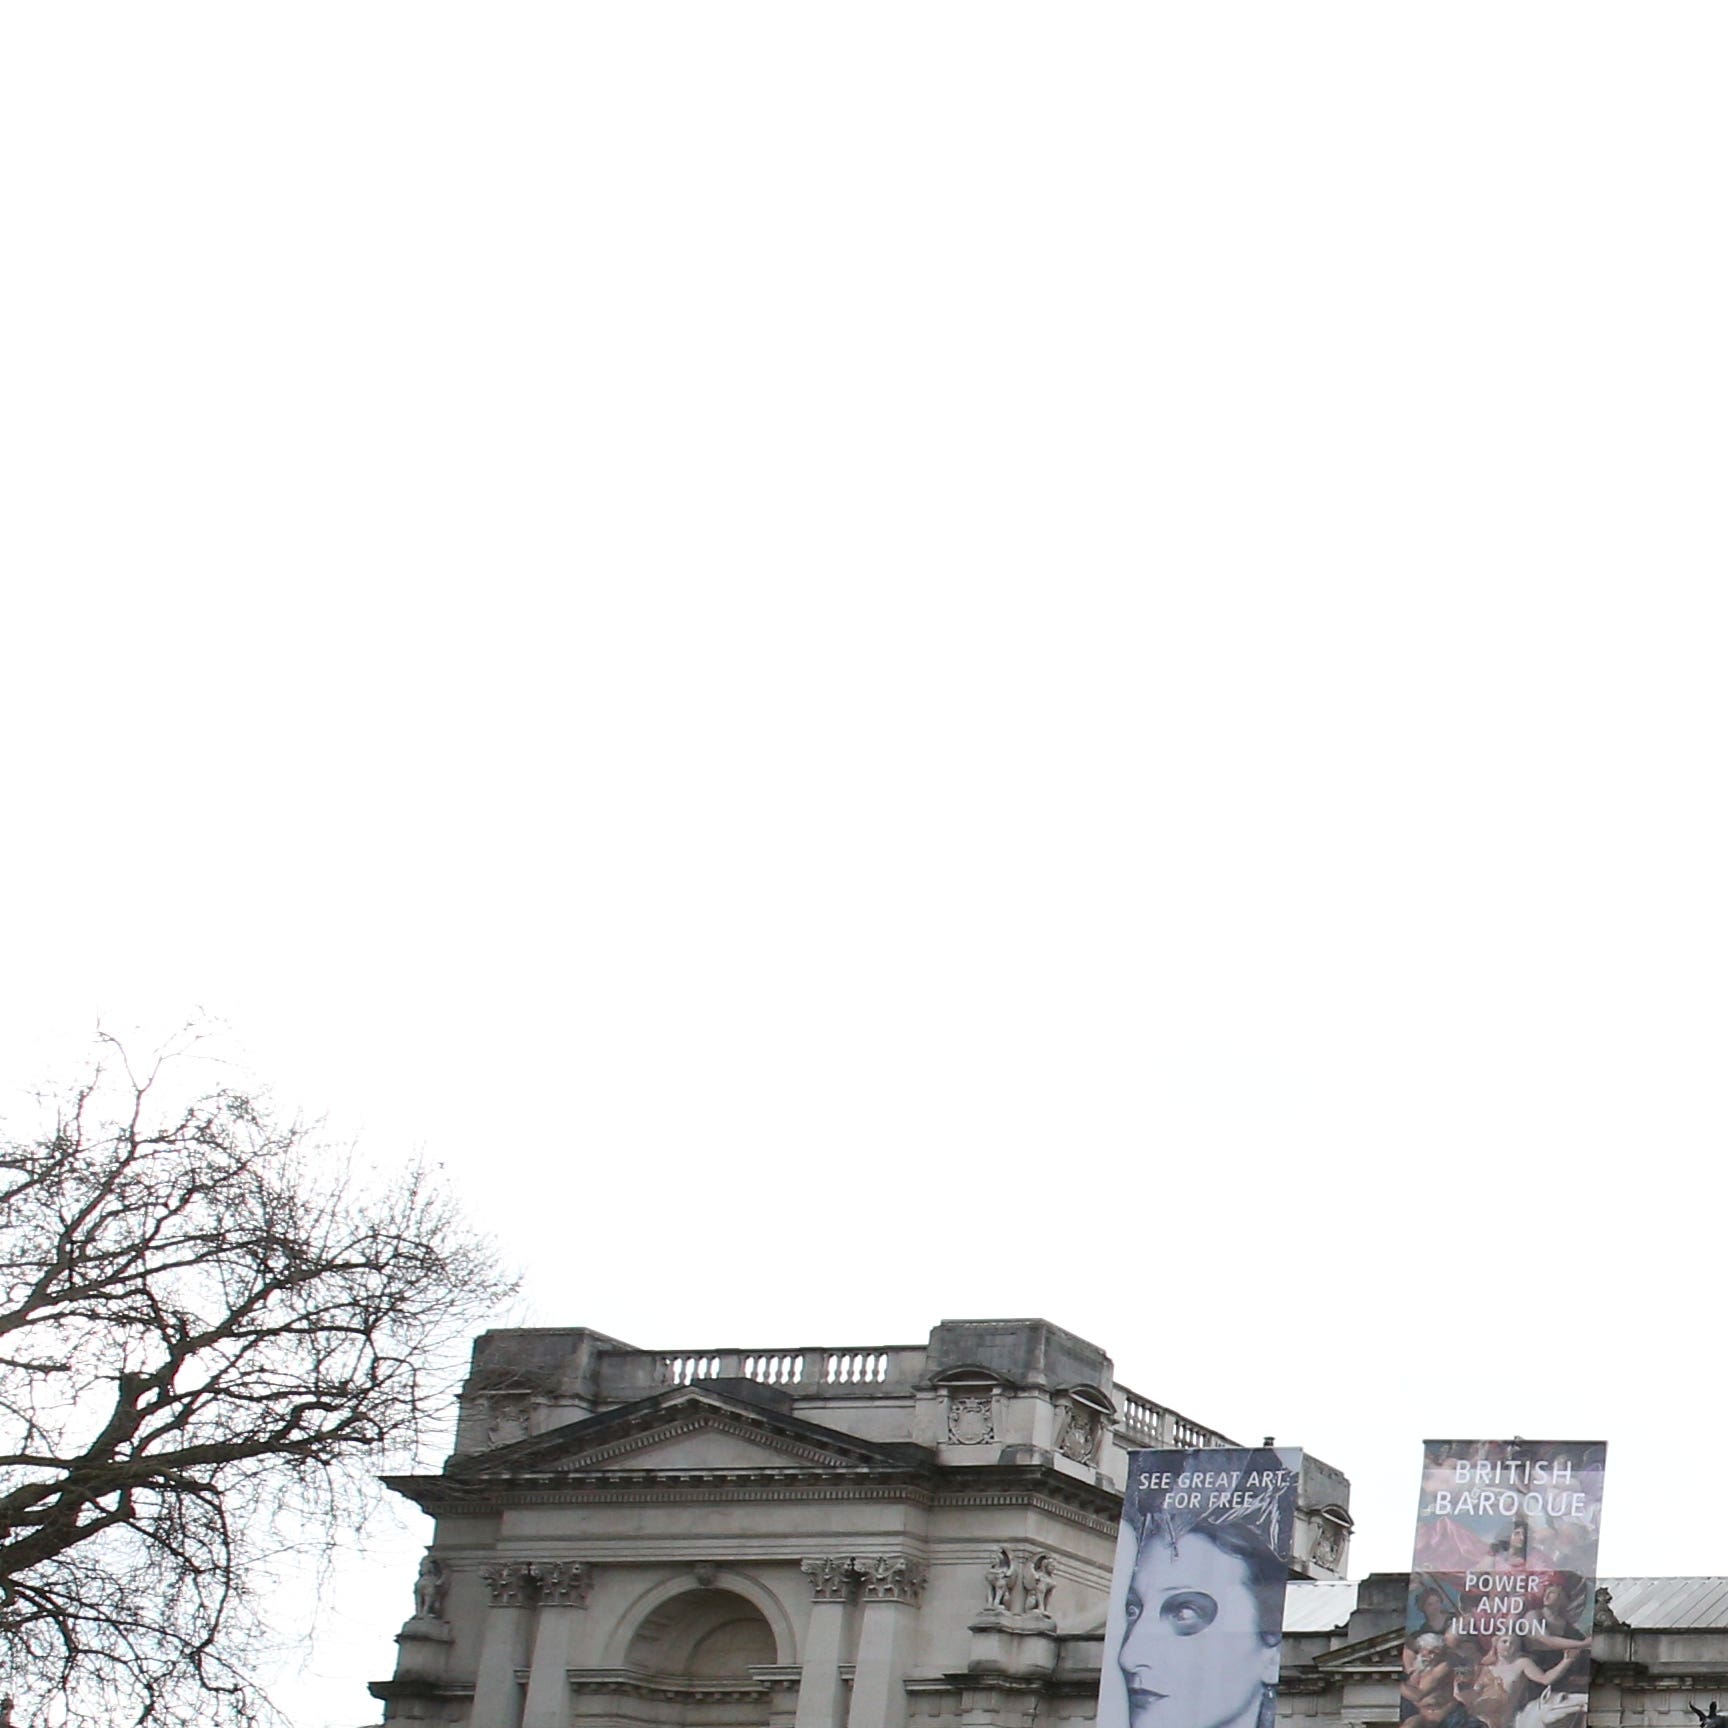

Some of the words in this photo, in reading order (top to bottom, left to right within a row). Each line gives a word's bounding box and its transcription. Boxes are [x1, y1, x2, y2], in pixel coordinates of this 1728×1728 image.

[1139, 1472, 1171, 1489] SEE
[1178, 1471, 1240, 1488] GREAT
[1247, 1470, 1287, 1487] ART
[1455, 1460, 1572, 1485] BRITISH
[1164, 1492, 1201, 1509] FOR
[1209, 1491, 1254, 1508] FREE
[1435, 1491, 1585, 1517] BAROQUE
[1465, 1574, 1540, 1592] POWER
[1477, 1596, 1523, 1614] AND
[1451, 1618, 1546, 1636] ILLUSION
